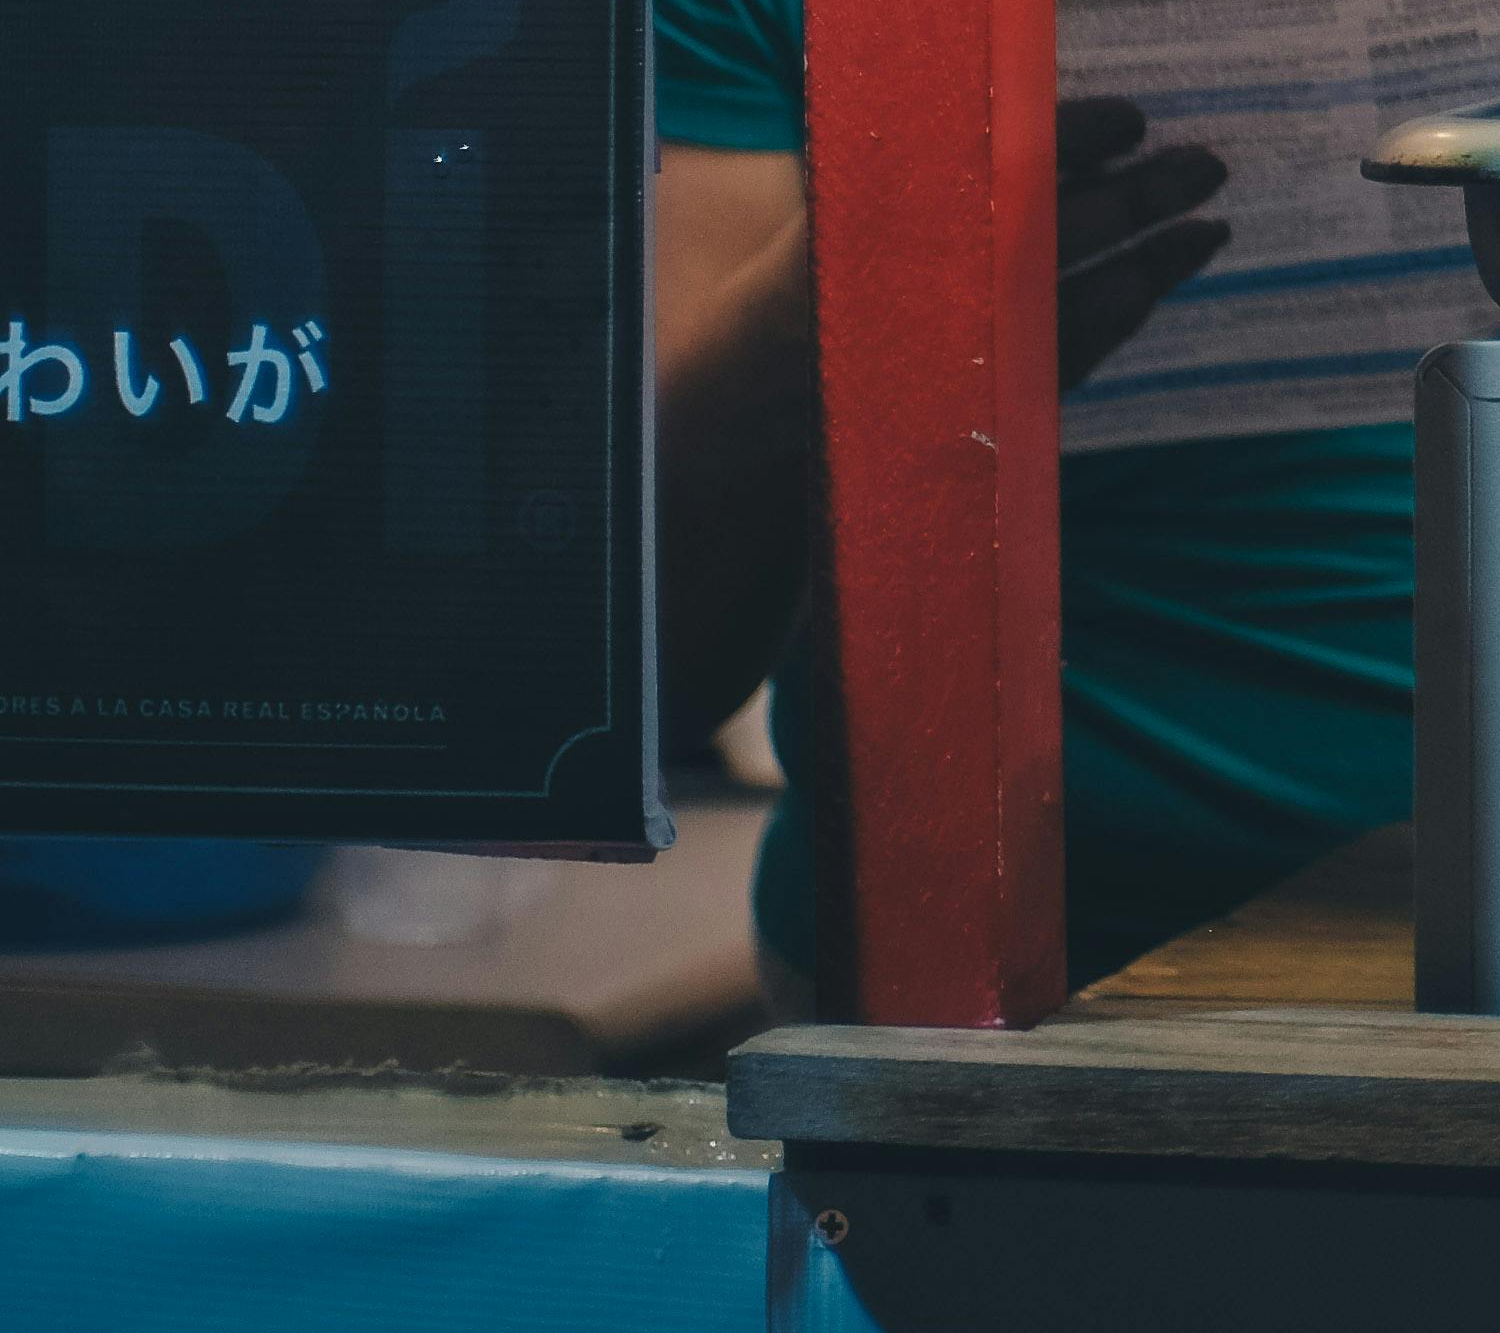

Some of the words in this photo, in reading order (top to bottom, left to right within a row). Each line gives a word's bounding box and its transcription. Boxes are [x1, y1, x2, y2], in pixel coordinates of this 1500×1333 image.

[0, 320, 328, 423] わいが
[97, 697, 129, 718] LA
[140, 697, 212, 719] CASA
[223, 700, 291, 721] REAL
